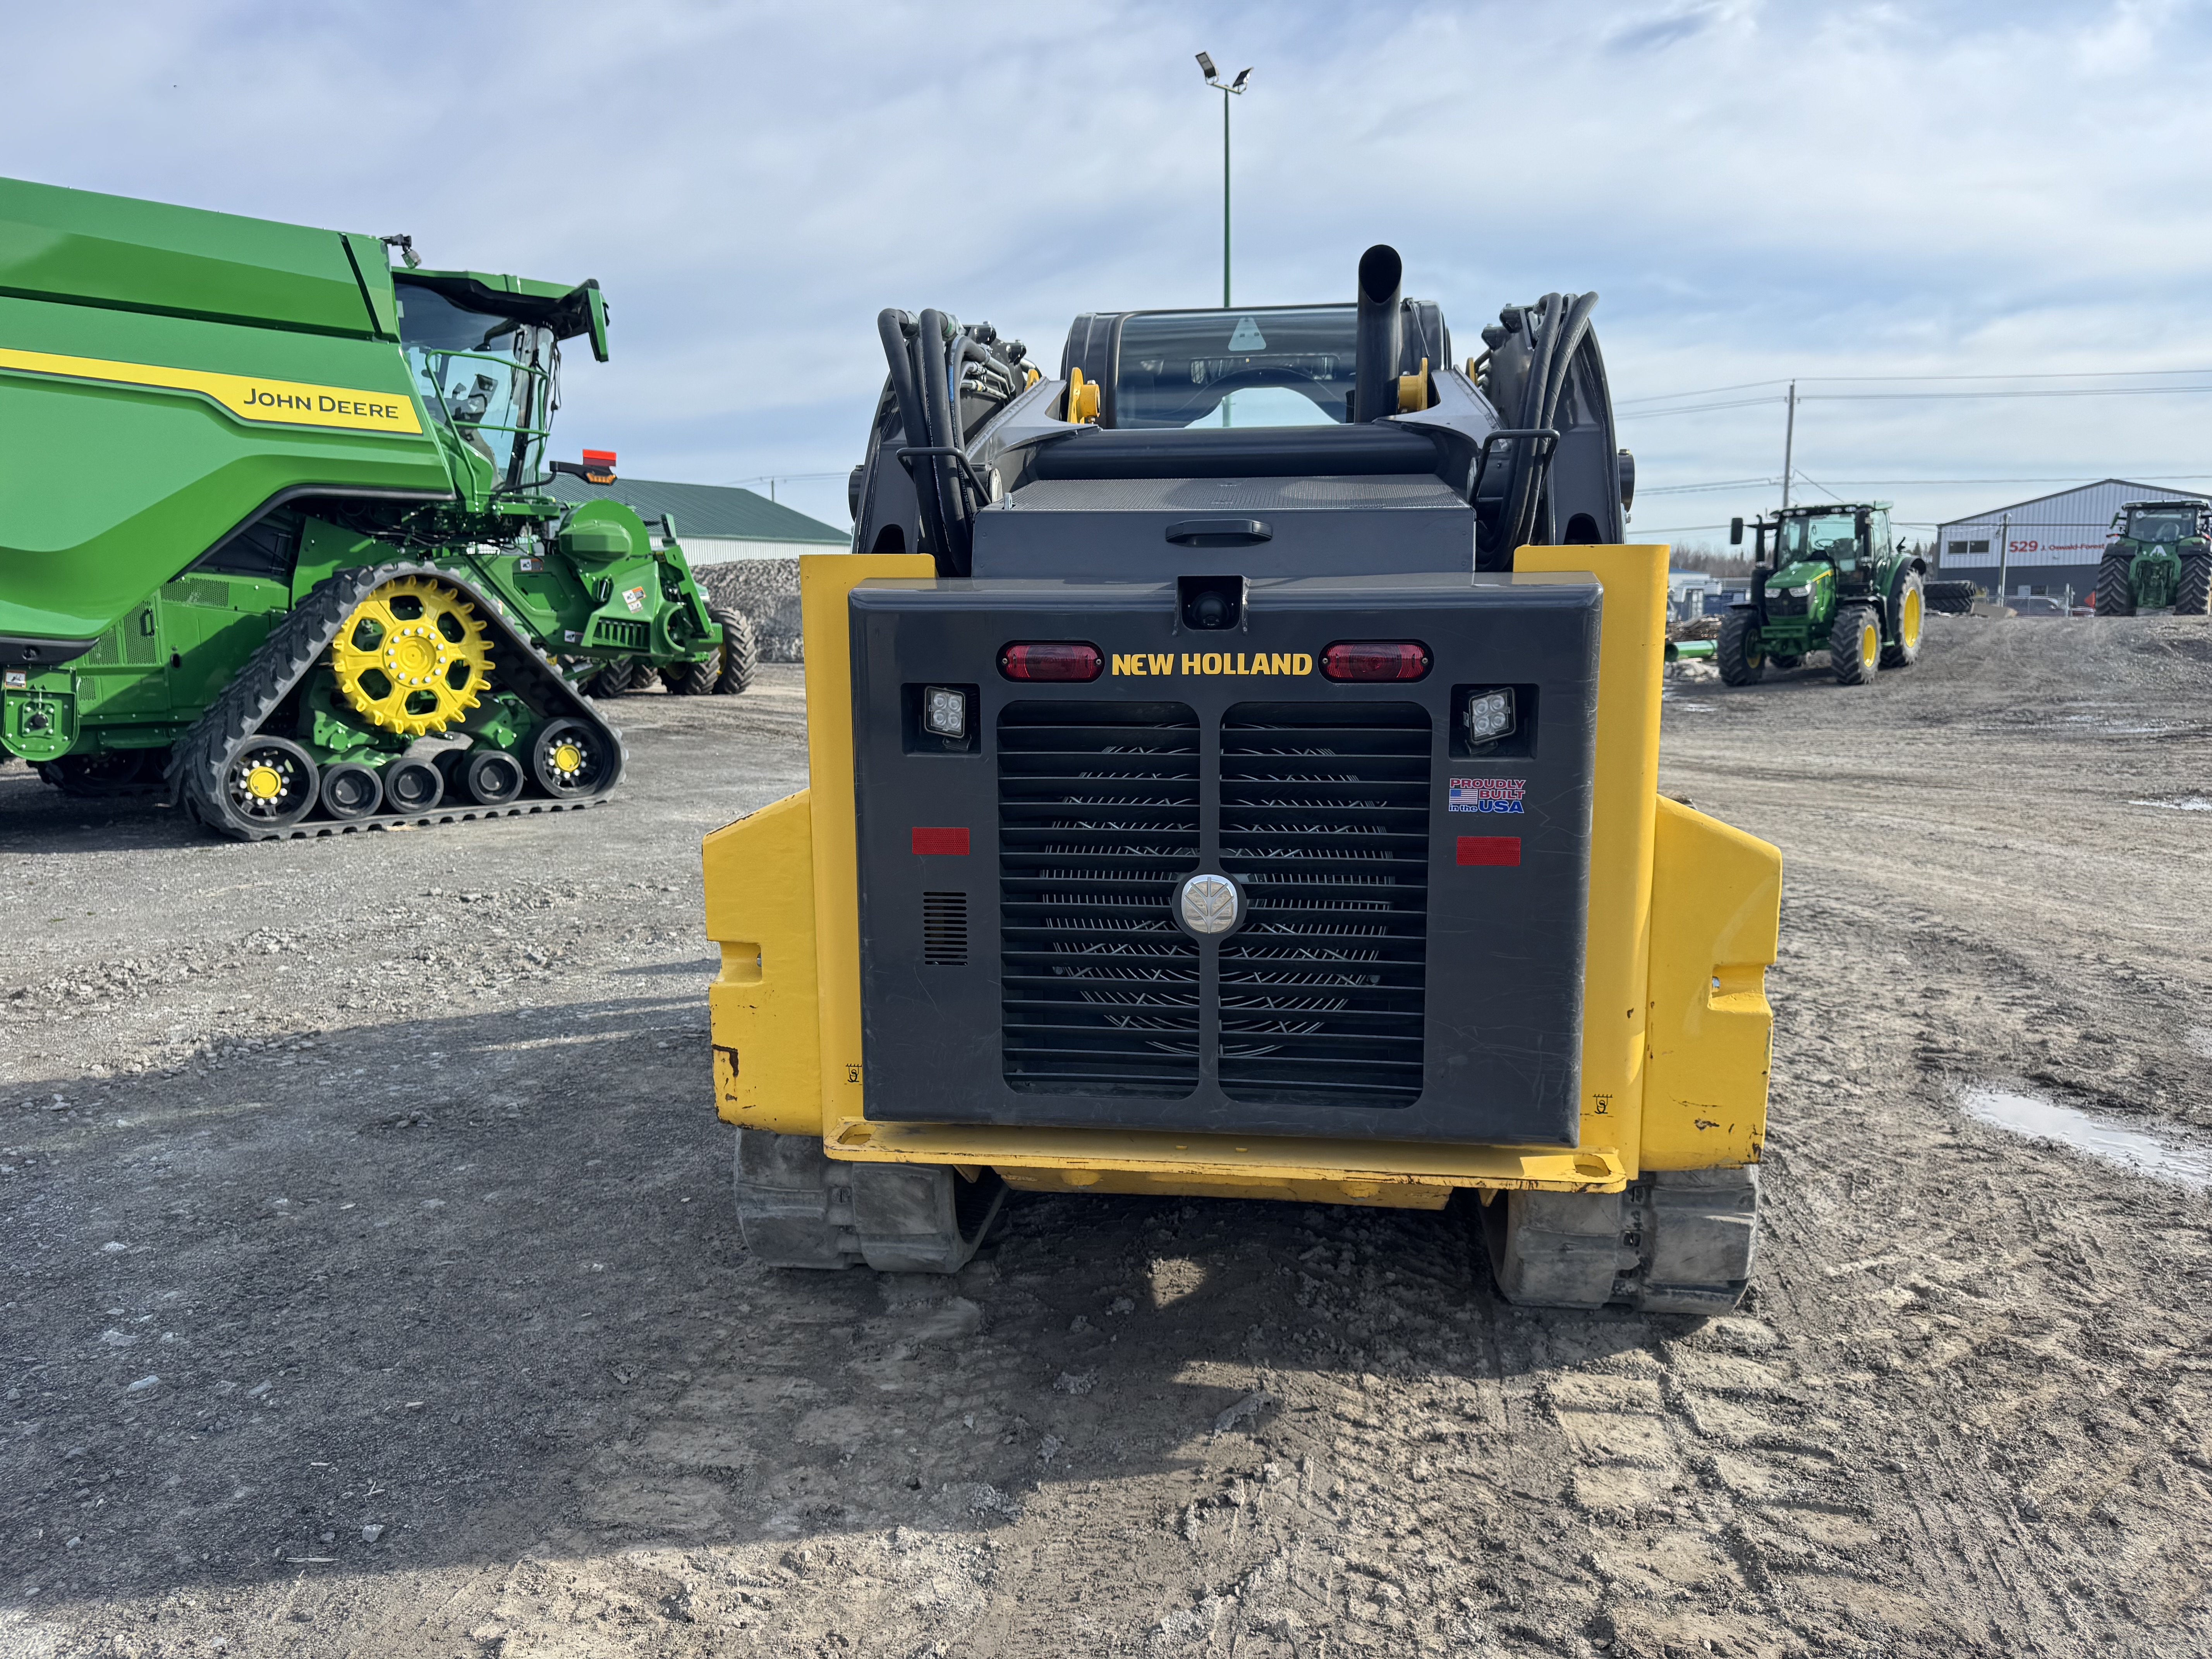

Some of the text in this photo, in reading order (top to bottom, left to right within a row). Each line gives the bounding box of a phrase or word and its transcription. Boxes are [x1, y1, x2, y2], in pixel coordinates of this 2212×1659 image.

[244, 388, 399, 419] JOHN DEERE
[2009, 541, 2038, 553] 529
[1112, 653, 1312, 675] NEW HOLLAND
[1450, 778, 1526, 789] PROUDLY
[1479, 789, 1525, 800] BUILT
[1478, 800, 1524, 813] USA
